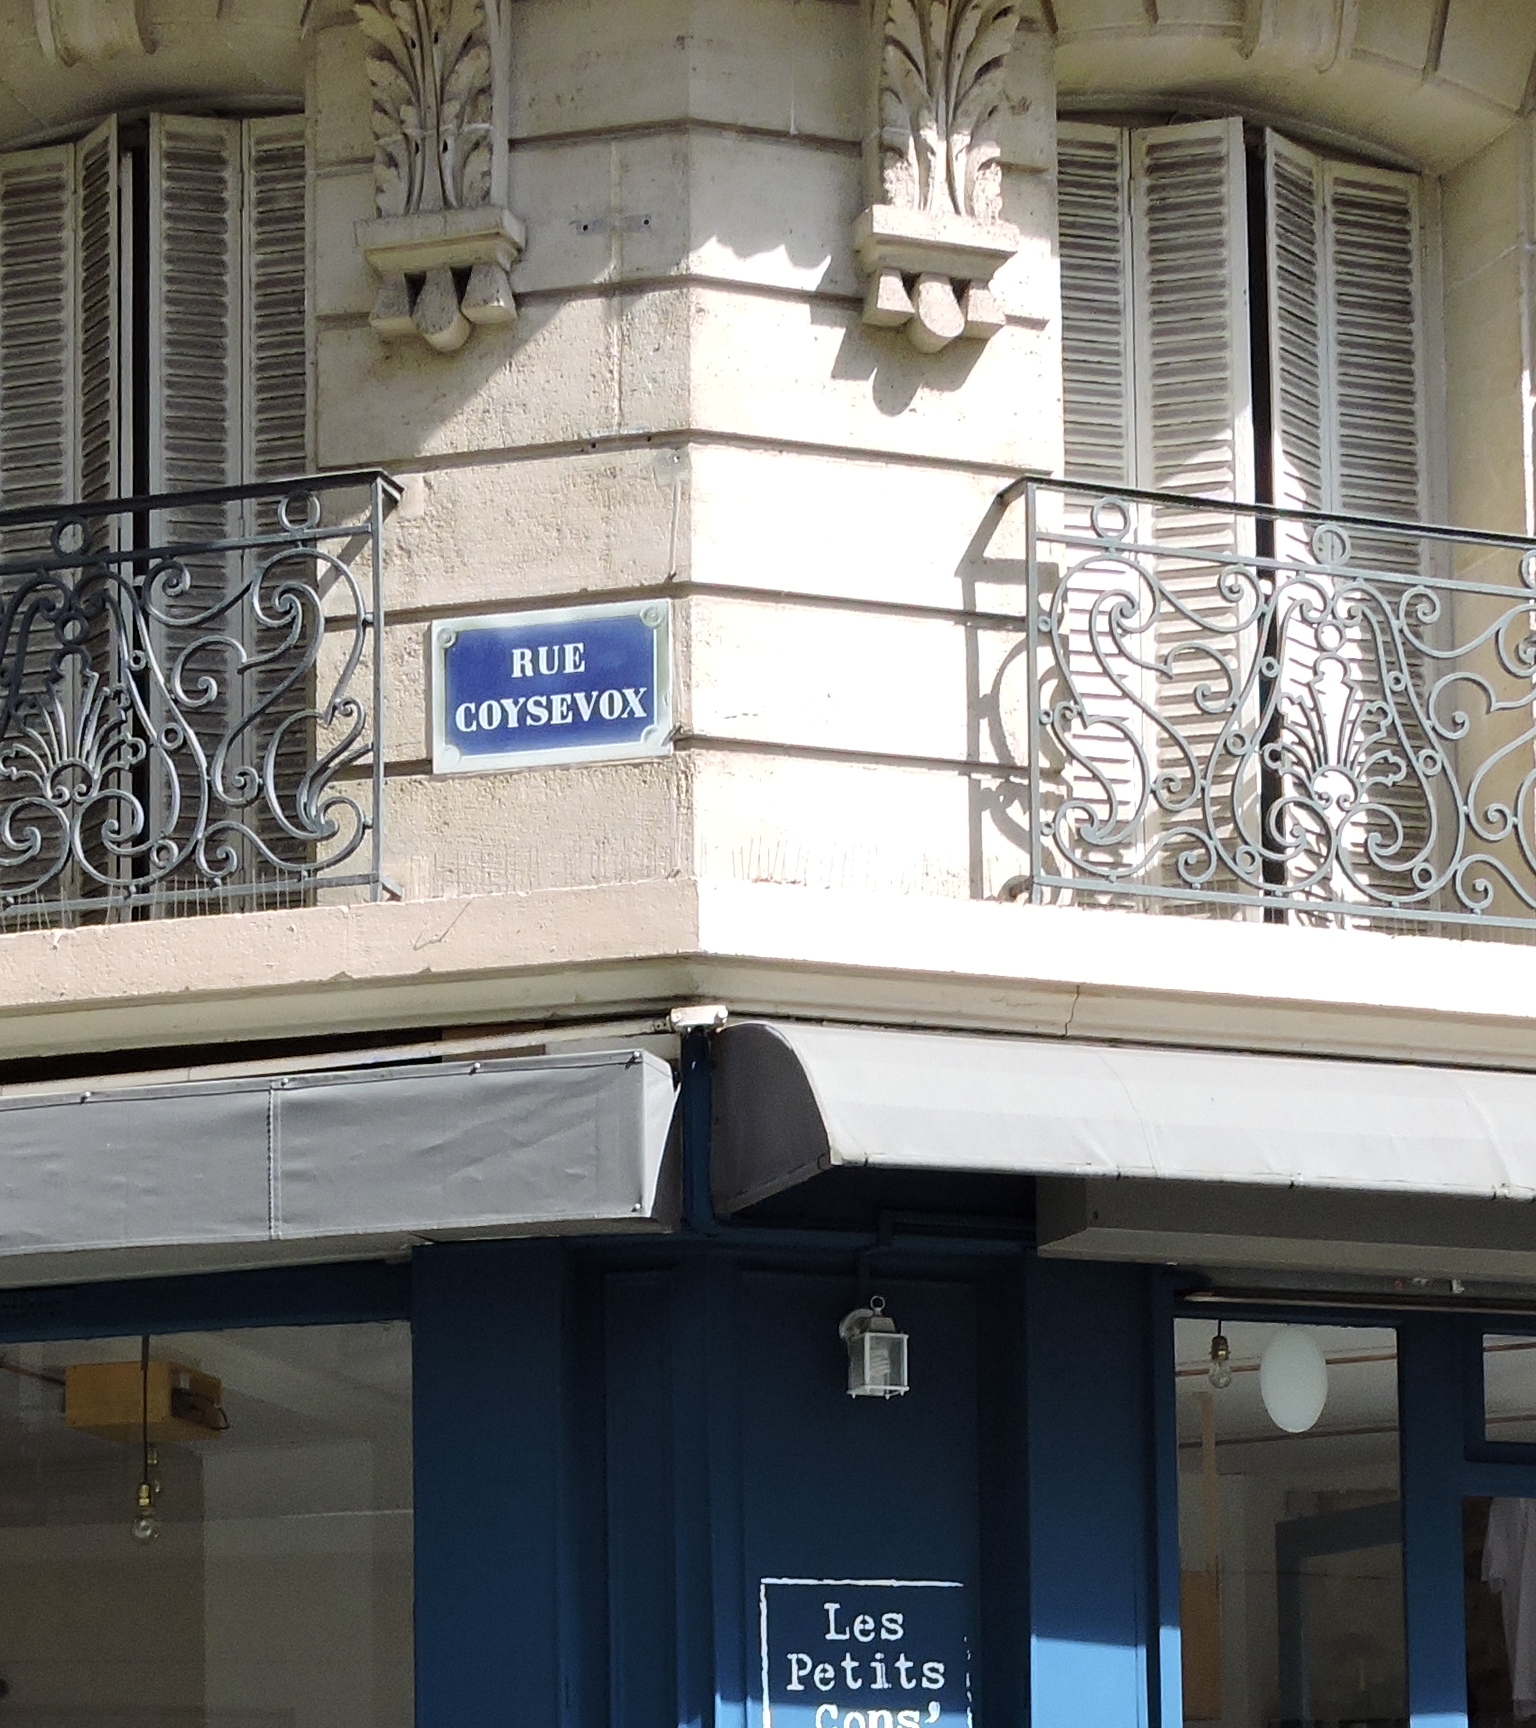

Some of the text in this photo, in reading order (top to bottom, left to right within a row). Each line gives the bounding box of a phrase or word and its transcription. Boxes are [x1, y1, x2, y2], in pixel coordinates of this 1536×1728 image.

[512, 642, 585, 678] RUE
[455, 687, 647, 732] COYSEVOX
[824, 1602, 904, 1642] Les
[786, 1652, 945, 1691] Petits
